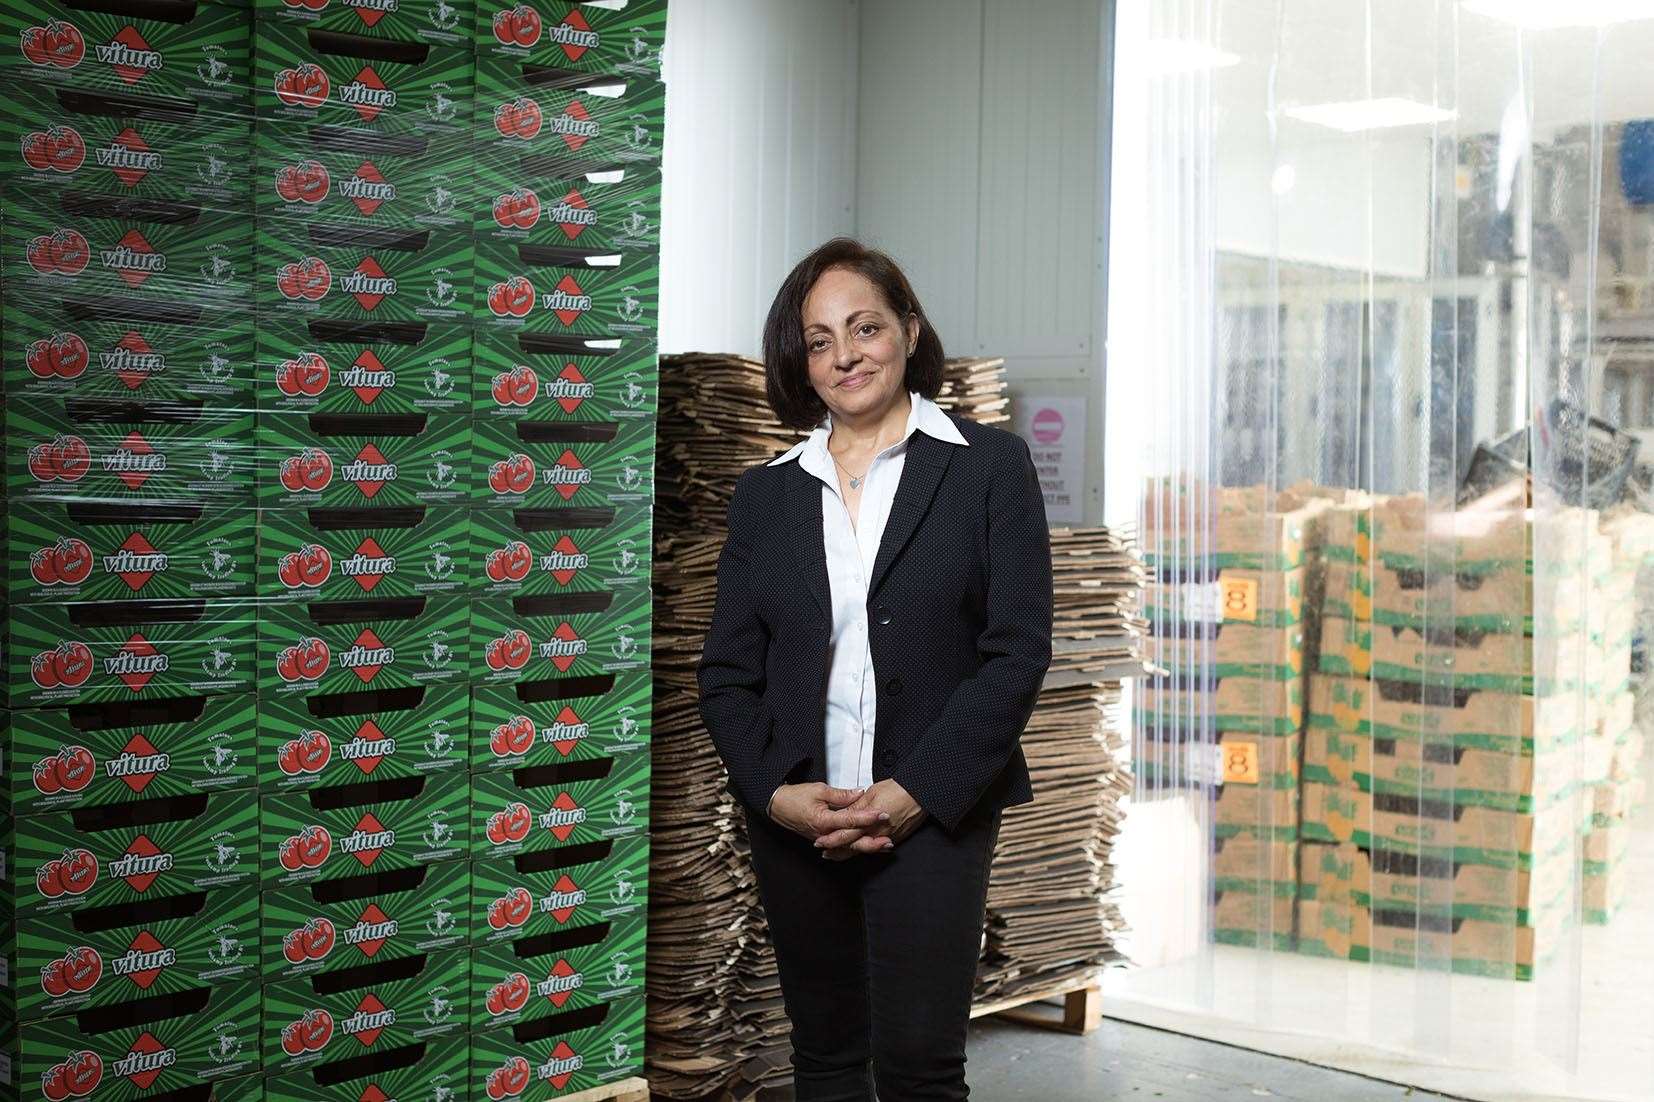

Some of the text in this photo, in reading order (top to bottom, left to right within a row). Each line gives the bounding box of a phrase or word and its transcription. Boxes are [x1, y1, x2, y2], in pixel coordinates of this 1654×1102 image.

[549, 23, 600, 48] vitura
[96, 41, 163, 70] vitura
[338, 81, 396, 107] vitura
[549, 113, 600, 137] vitura
[95, 143, 162, 170] vitura
[338, 176, 396, 200] vitura
[548, 202, 598, 225] vitura
[100, 246, 166, 271] vitura
[340, 271, 397, 294] vitura
[541, 290, 592, 311] vitura
[99, 347, 166, 371] vitura
[338, 365, 396, 387] vitura
[545, 377, 594, 398] vitura
[101, 449, 166, 471] vitura
[341, 460, 397, 481] vitura
[542, 464, 592, 484] vitura
[102, 550, 168, 572] vitura
[340, 554, 396, 575] vitura
[540, 551, 588, 571] vitura
[339, 646, 394, 667] vitura
[539, 637, 587, 658] vitura
[104, 652, 169, 674] vitura
[541, 722, 589, 742] vitura
[339, 737, 396, 759] vitura
[104, 753, 170, 777] vitura
[538, 808, 586, 829] vitura
[339, 830, 395, 853] vitura
[108, 853, 173, 878] vitura
[540, 890, 587, 912] vitura
[343, 920, 398, 944] vitura
[111, 948, 176, 975] vitura
[537, 973, 583, 996] vitura
[341, 1009, 396, 1034] vitura
[112, 1048, 176, 1077] vitura
[537, 1055, 583, 1080] vitura
